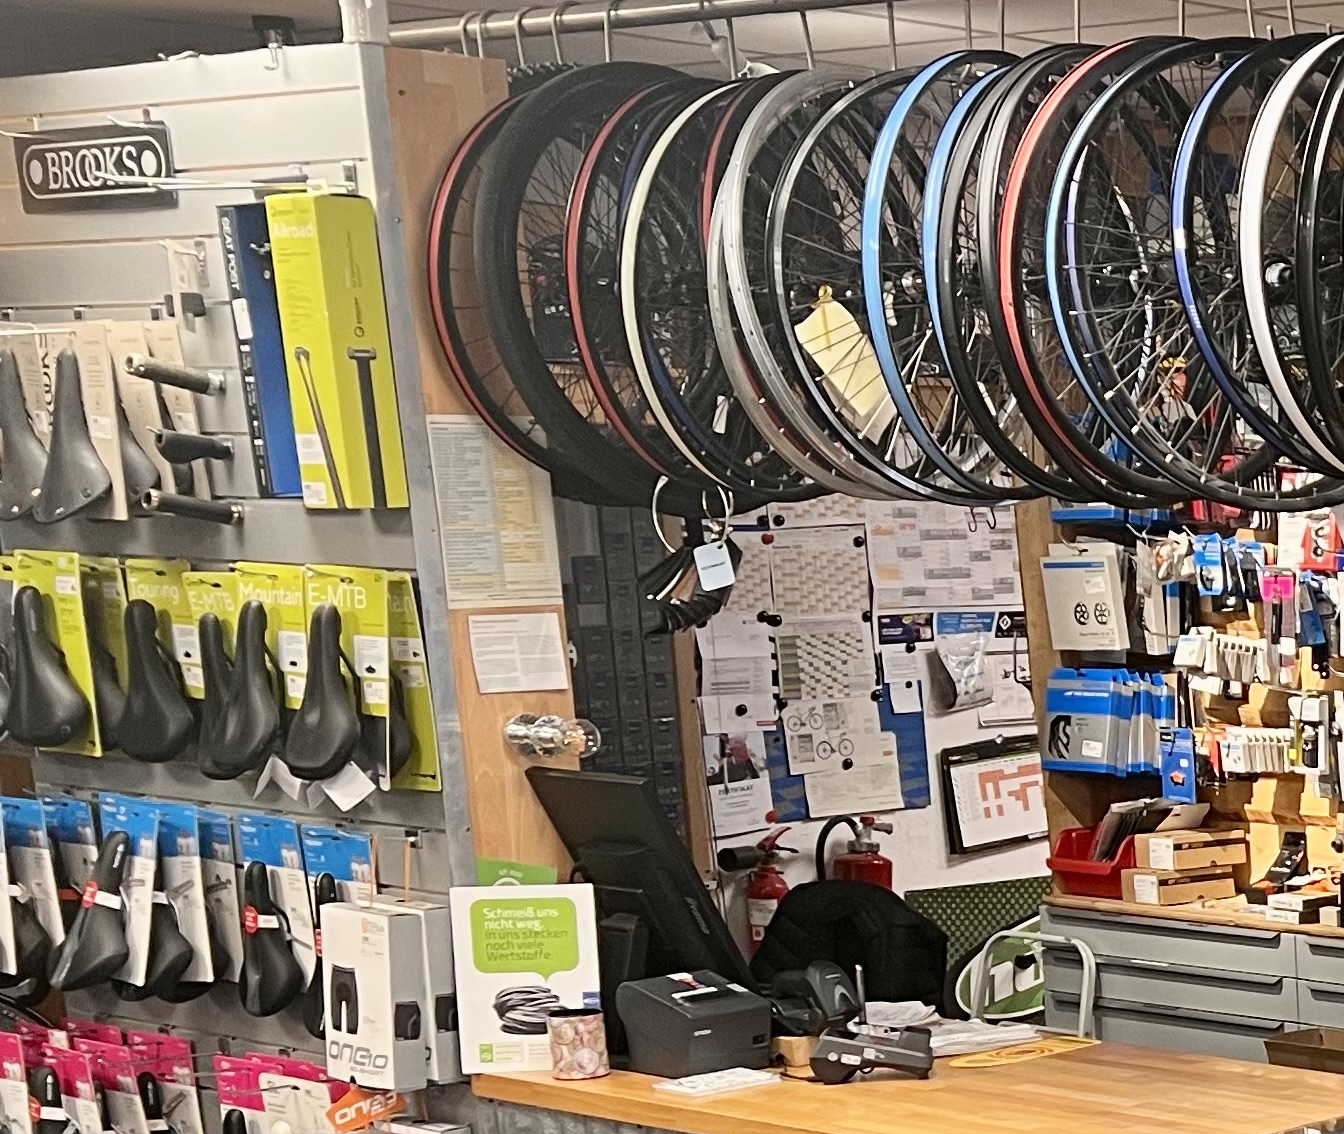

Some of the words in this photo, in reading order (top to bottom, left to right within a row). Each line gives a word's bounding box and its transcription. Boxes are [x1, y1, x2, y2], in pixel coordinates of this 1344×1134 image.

[46, 144, 140, 190] BROOKS
[129, 578, 180, 606] Touring
[238, 579, 302, 607] Mountain
[308, 586, 367, 609] E-MTB
[190, 591, 236, 612] E-MTB
[483, 907, 534, 919] Schmeiß
[536, 908, 559, 918] uns
[484, 919, 513, 930] nicht
[485, 930, 496, 940] In
[498, 930, 520, 940] uns
[522, 929, 569, 940] stecken
[485, 939, 512, 951] noch
[515, 939, 544, 950] viele
[486, 950, 553, 962] Wertstoffe.
